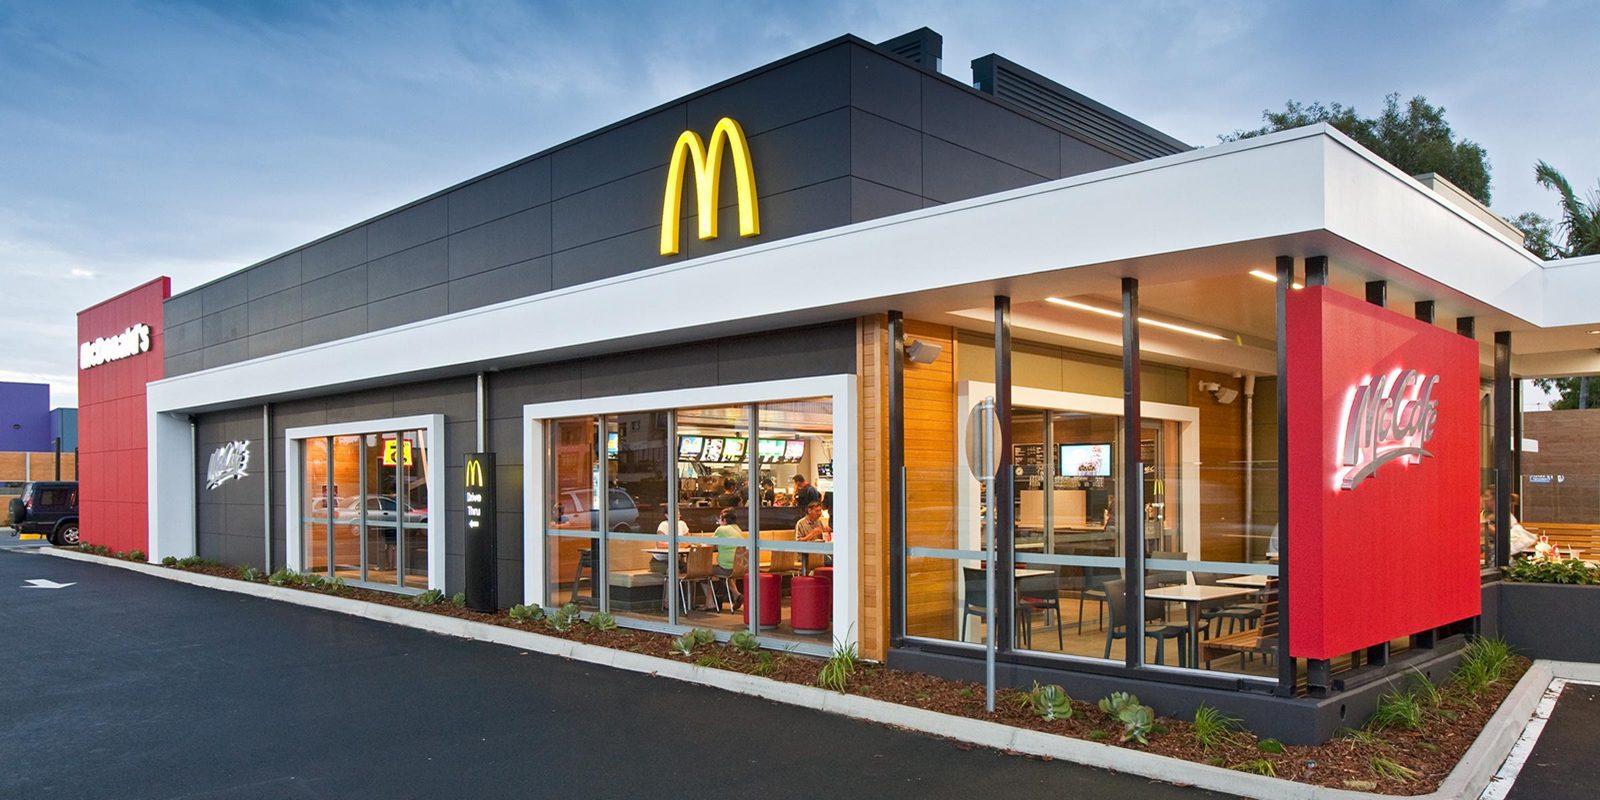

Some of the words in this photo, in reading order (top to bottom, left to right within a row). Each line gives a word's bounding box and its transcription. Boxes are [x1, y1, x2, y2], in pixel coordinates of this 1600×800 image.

[660, 117, 761, 256] M
[466, 491, 482, 502] Drive
[467, 505, 481, 516] Thru
